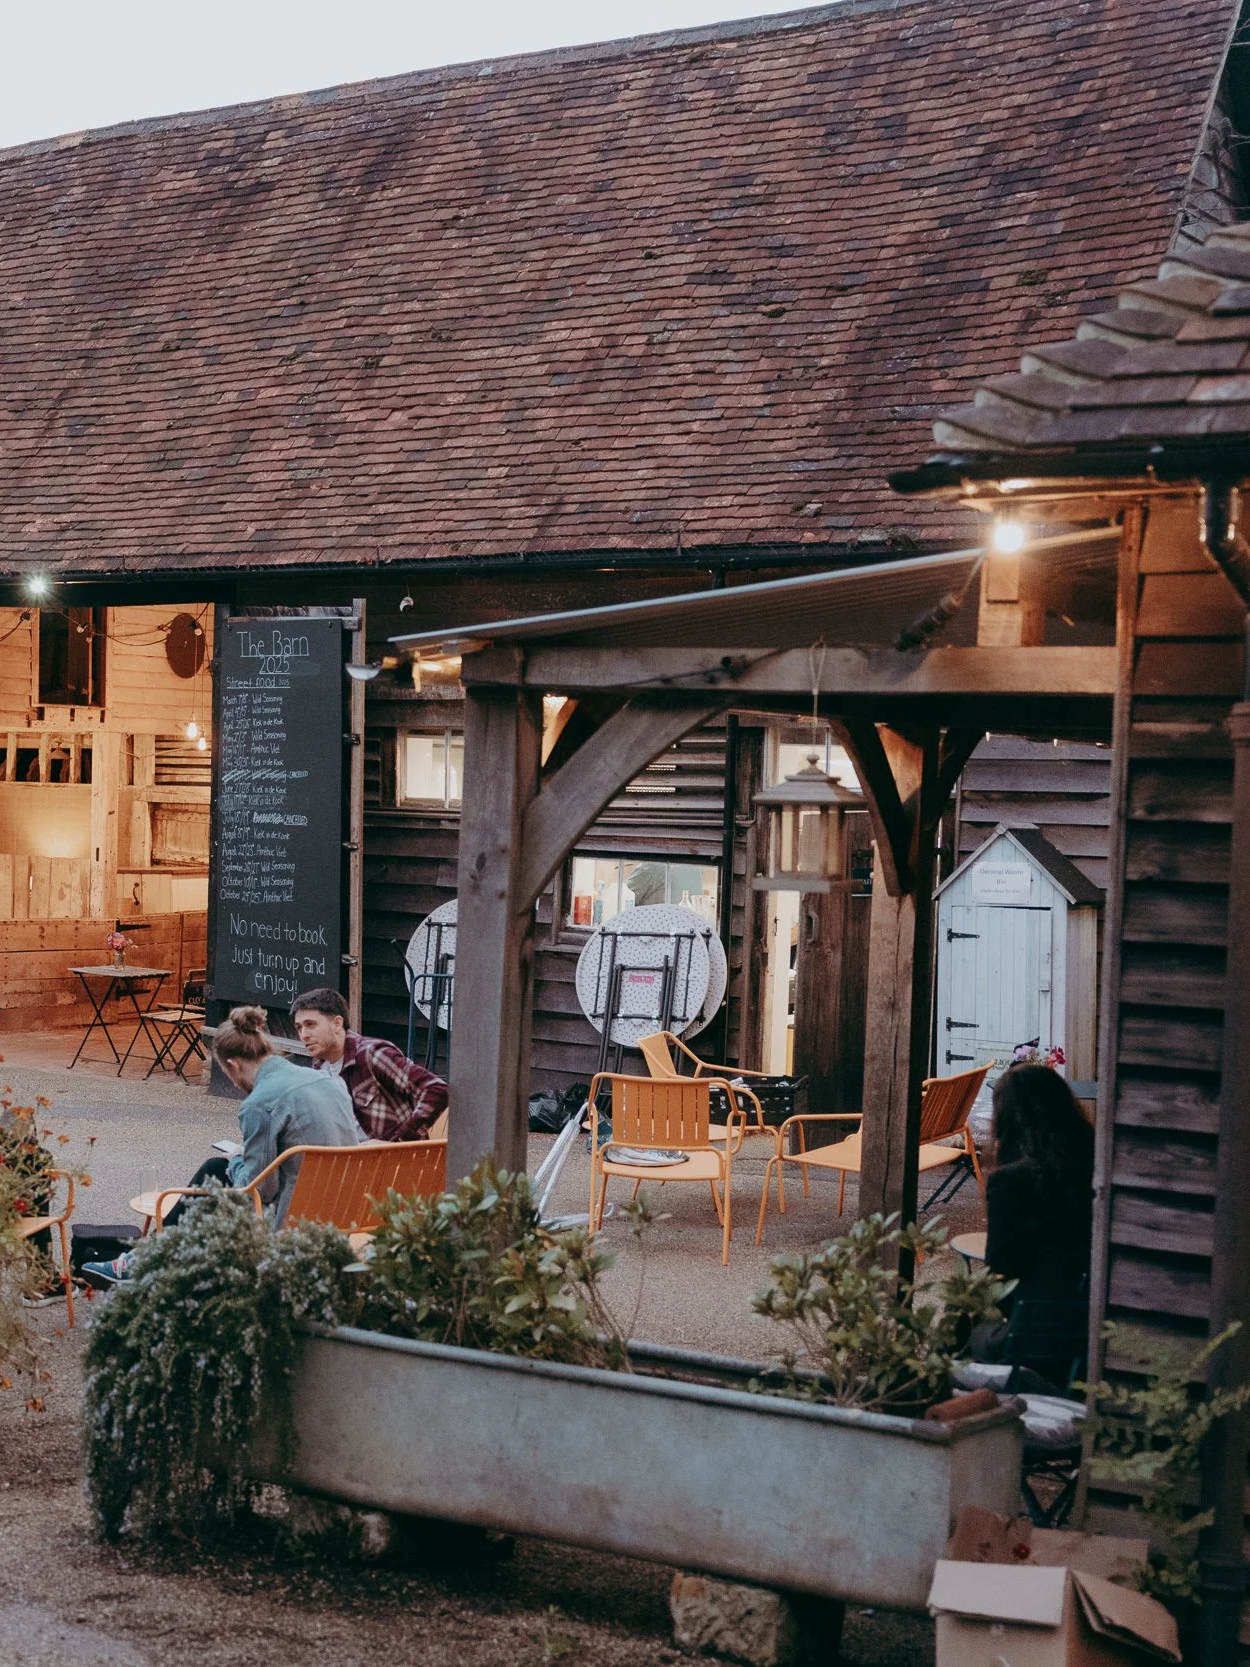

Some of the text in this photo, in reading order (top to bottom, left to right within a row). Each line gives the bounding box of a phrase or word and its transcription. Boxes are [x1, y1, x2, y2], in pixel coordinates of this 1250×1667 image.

[236, 630, 309, 656] The Barn
[259, 655, 291, 674] 2025
[226, 676, 252, 688] Street
[230, 912, 248, 936] No
[250, 921, 281, 941] need
[283, 921, 297, 941] to
[257, 947, 283, 970] turn
[285, 956, 300, 977] up
[303, 956, 325, 975] and
[254, 971, 298, 1005] enjoy!
